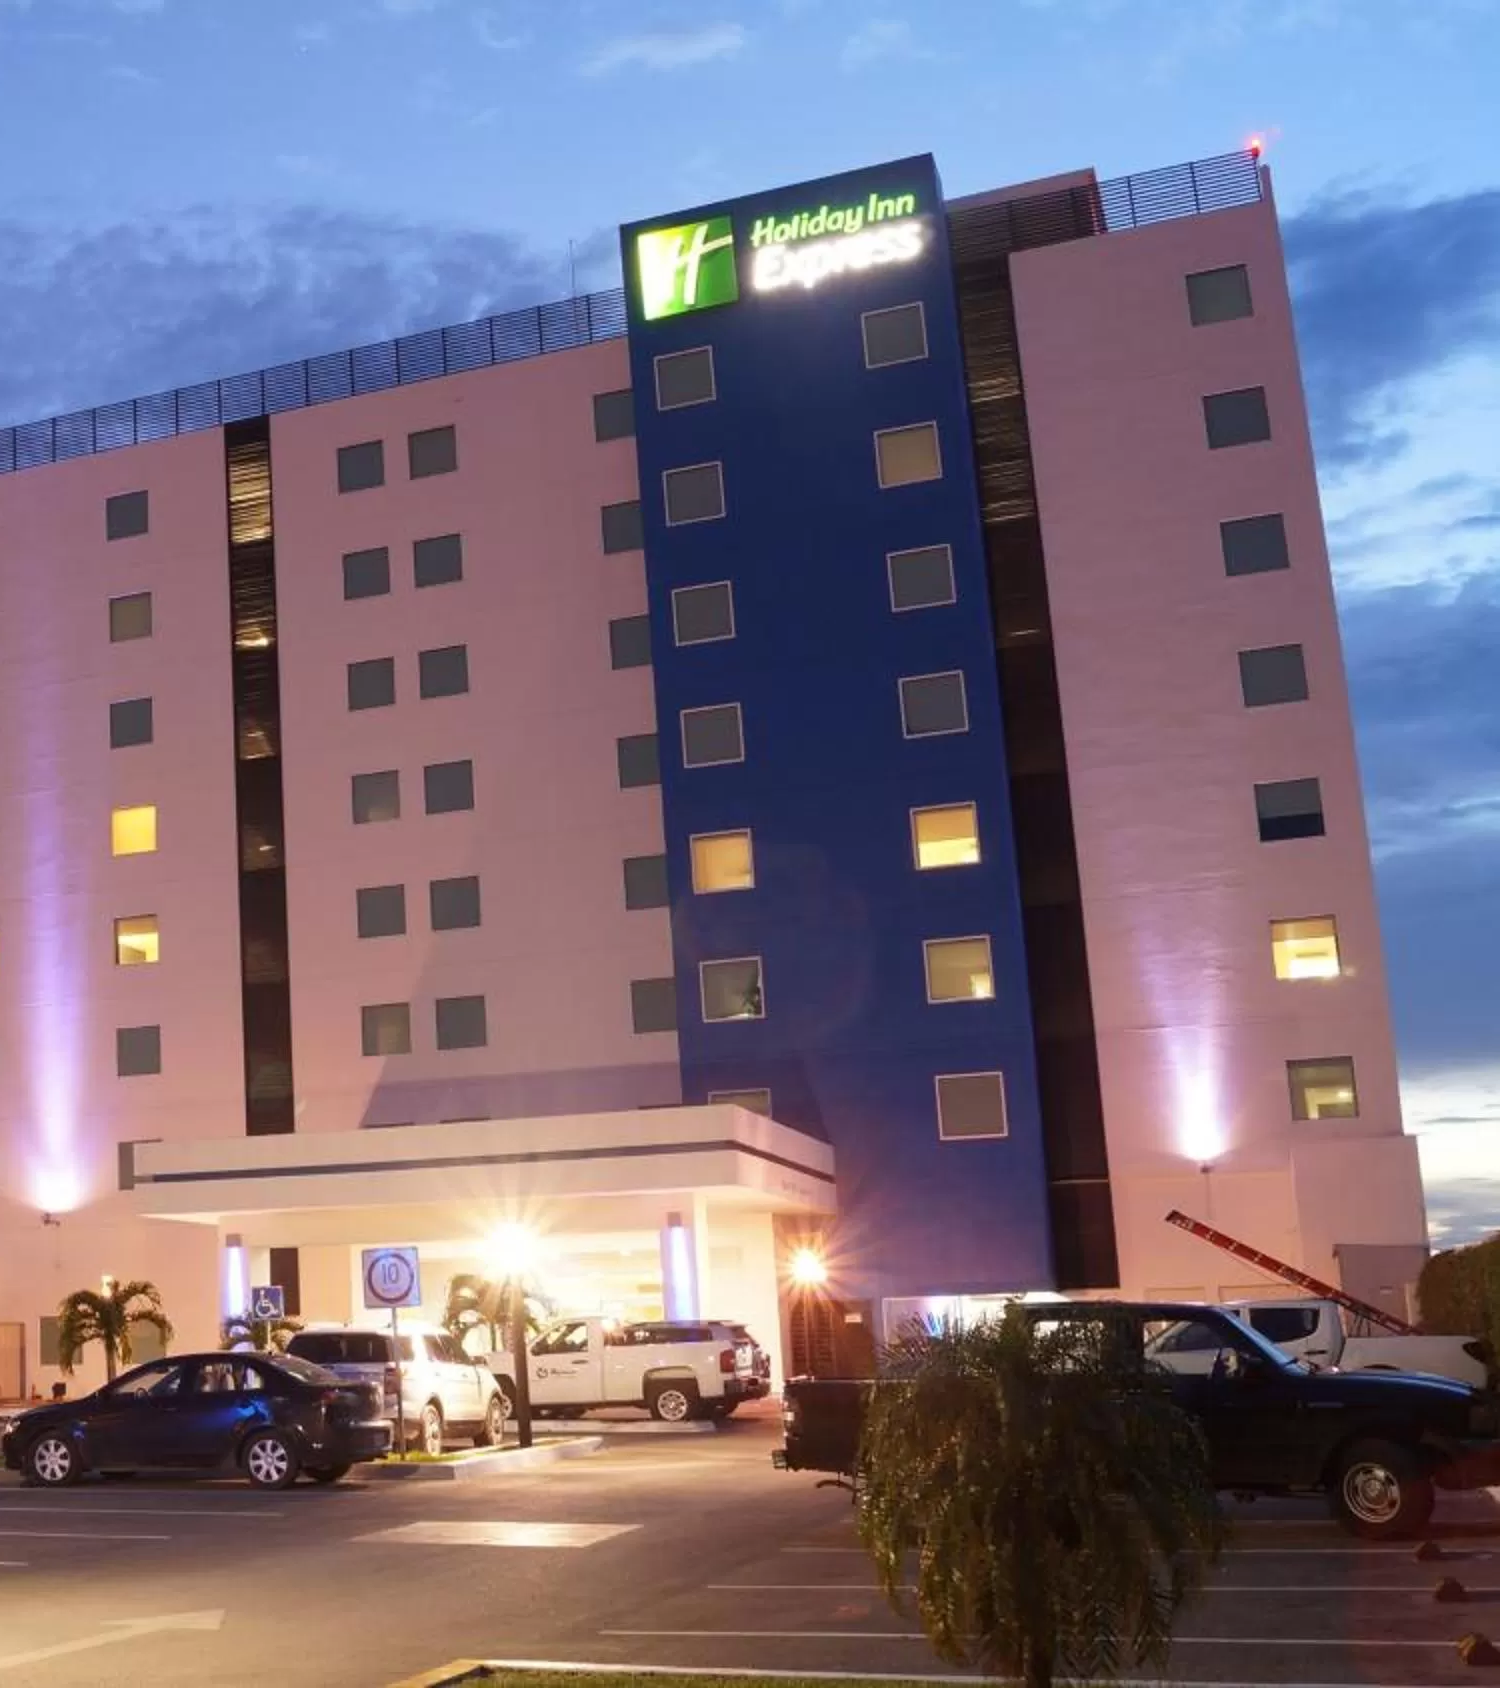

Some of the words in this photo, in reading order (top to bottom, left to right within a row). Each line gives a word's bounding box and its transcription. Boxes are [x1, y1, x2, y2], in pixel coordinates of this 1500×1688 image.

[750, 205, 863, 247] Holiday
[867, 193, 914, 221] Inn
[752, 222, 923, 291] Express
[381, 1262, 400, 1285] 10
